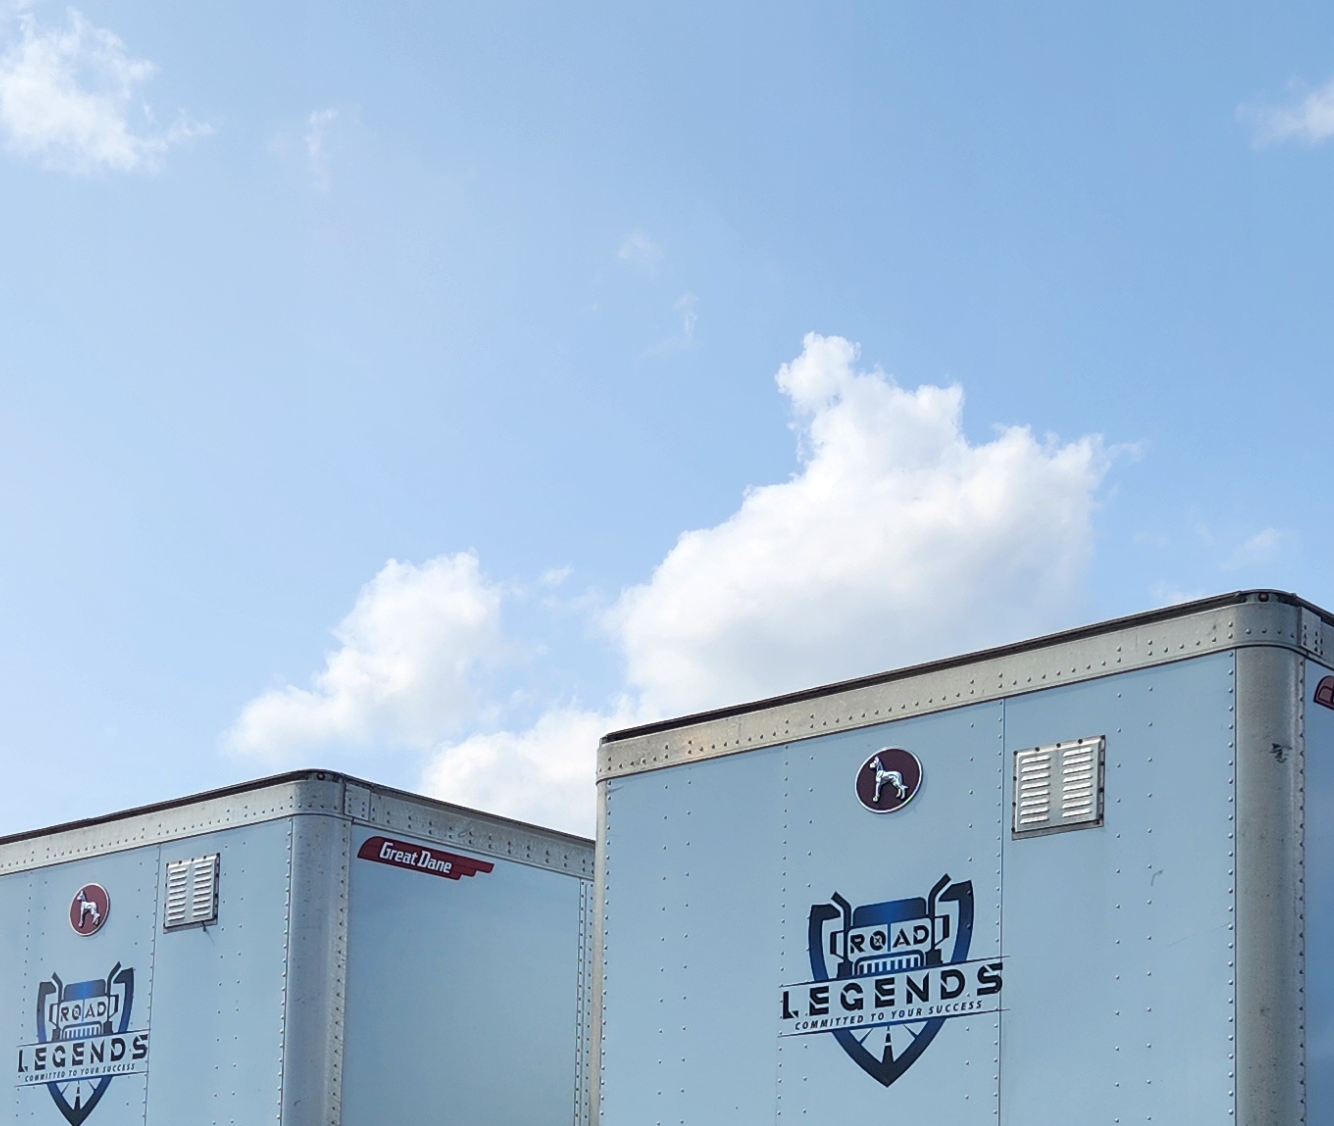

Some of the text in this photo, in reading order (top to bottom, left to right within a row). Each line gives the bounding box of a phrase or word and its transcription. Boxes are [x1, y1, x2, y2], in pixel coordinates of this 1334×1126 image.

[379, 841, 452, 873] Great Dane
[850, 925, 930, 954] ROAD
[782, 962, 1003, 1019] LEGENDS
[60, 1001, 107, 1022] ROAD
[795, 1000, 983, 1031] COMMITTED TO YOUR SUCCESS
[18, 1034, 148, 1072] LEGENDS
[25, 1063, 136, 1082] COMMITTED TO YOUR SUCCESS
